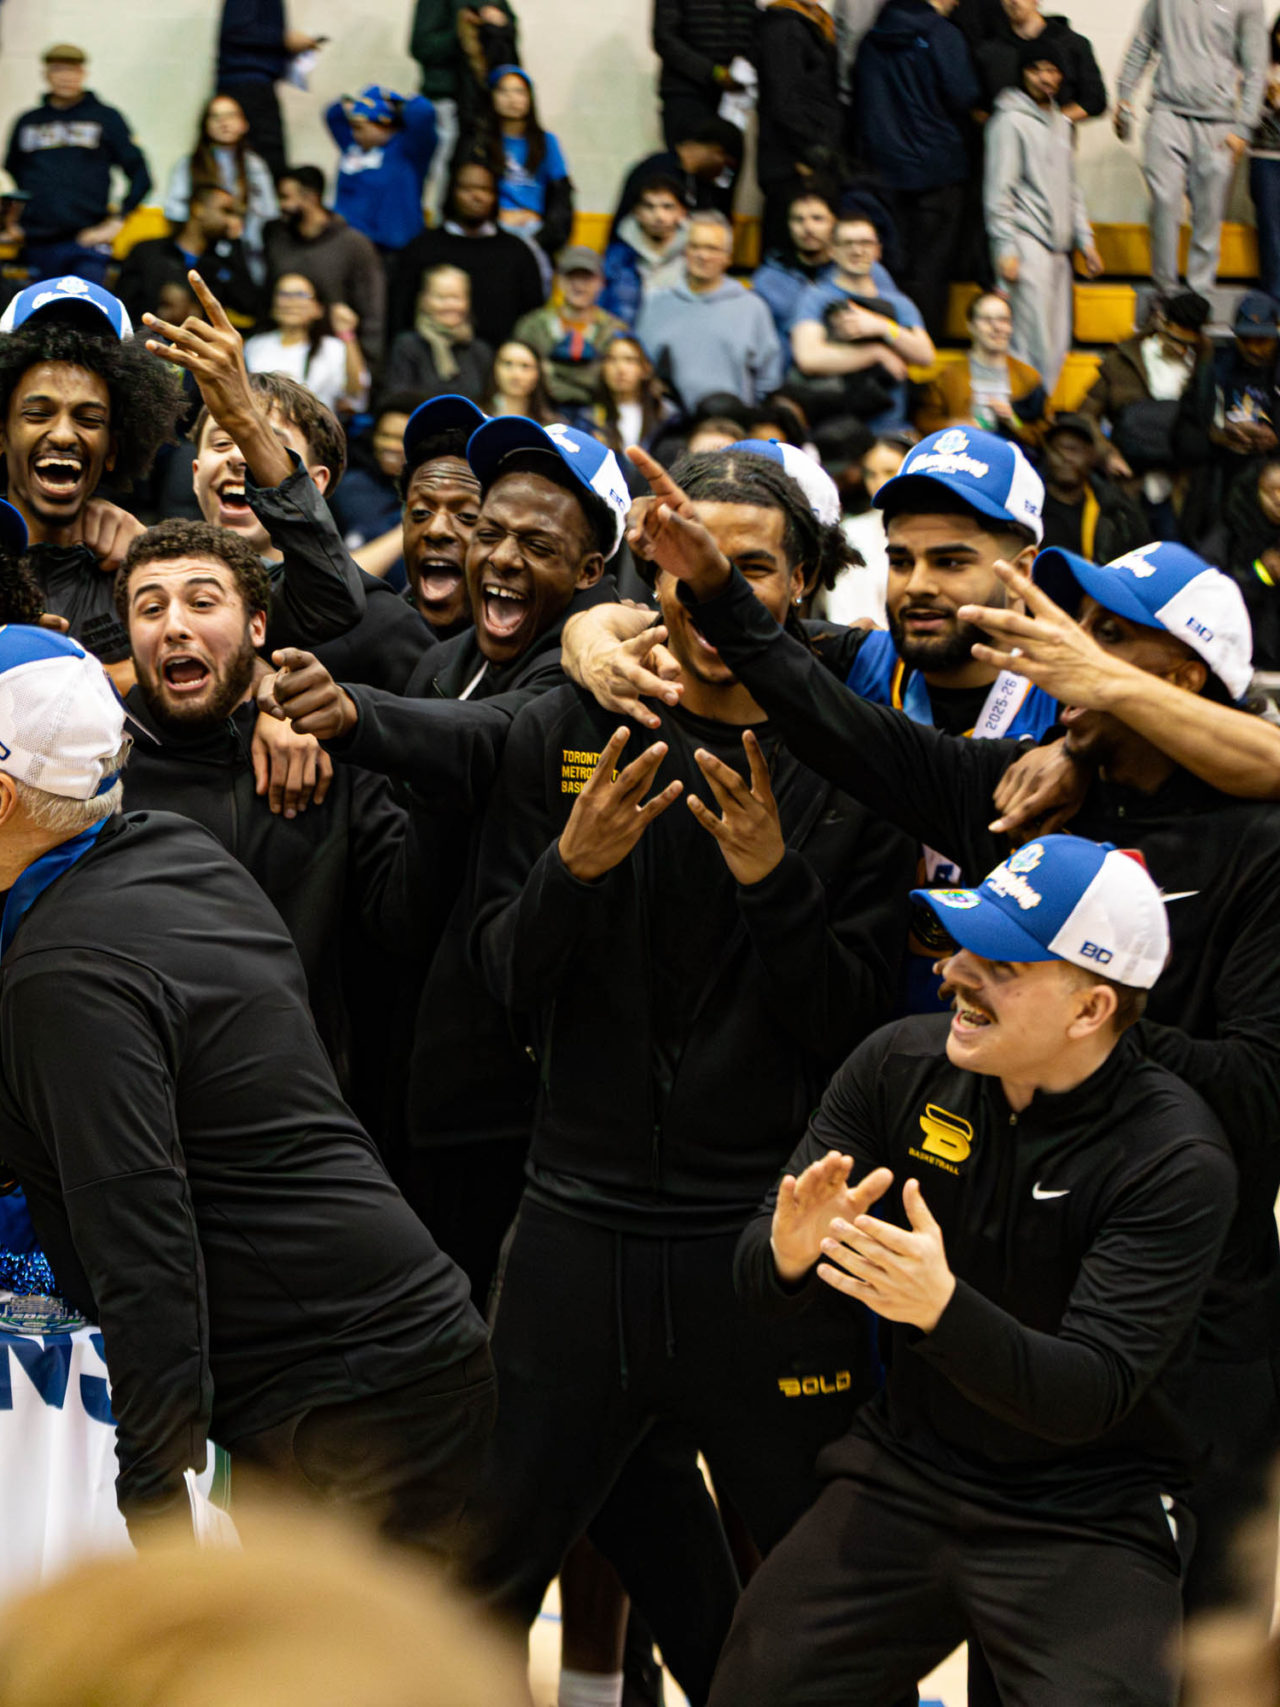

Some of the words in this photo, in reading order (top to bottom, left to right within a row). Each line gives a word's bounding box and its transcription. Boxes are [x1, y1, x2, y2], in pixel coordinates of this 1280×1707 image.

[984, 678, 1018, 731] 2025-26
[562, 749, 602, 765] TORONT
[1080, 940, 1114, 965] BD
[908, 1146, 960, 1176] BASKETBALL
[777, 1370, 852, 1398] BOLD
